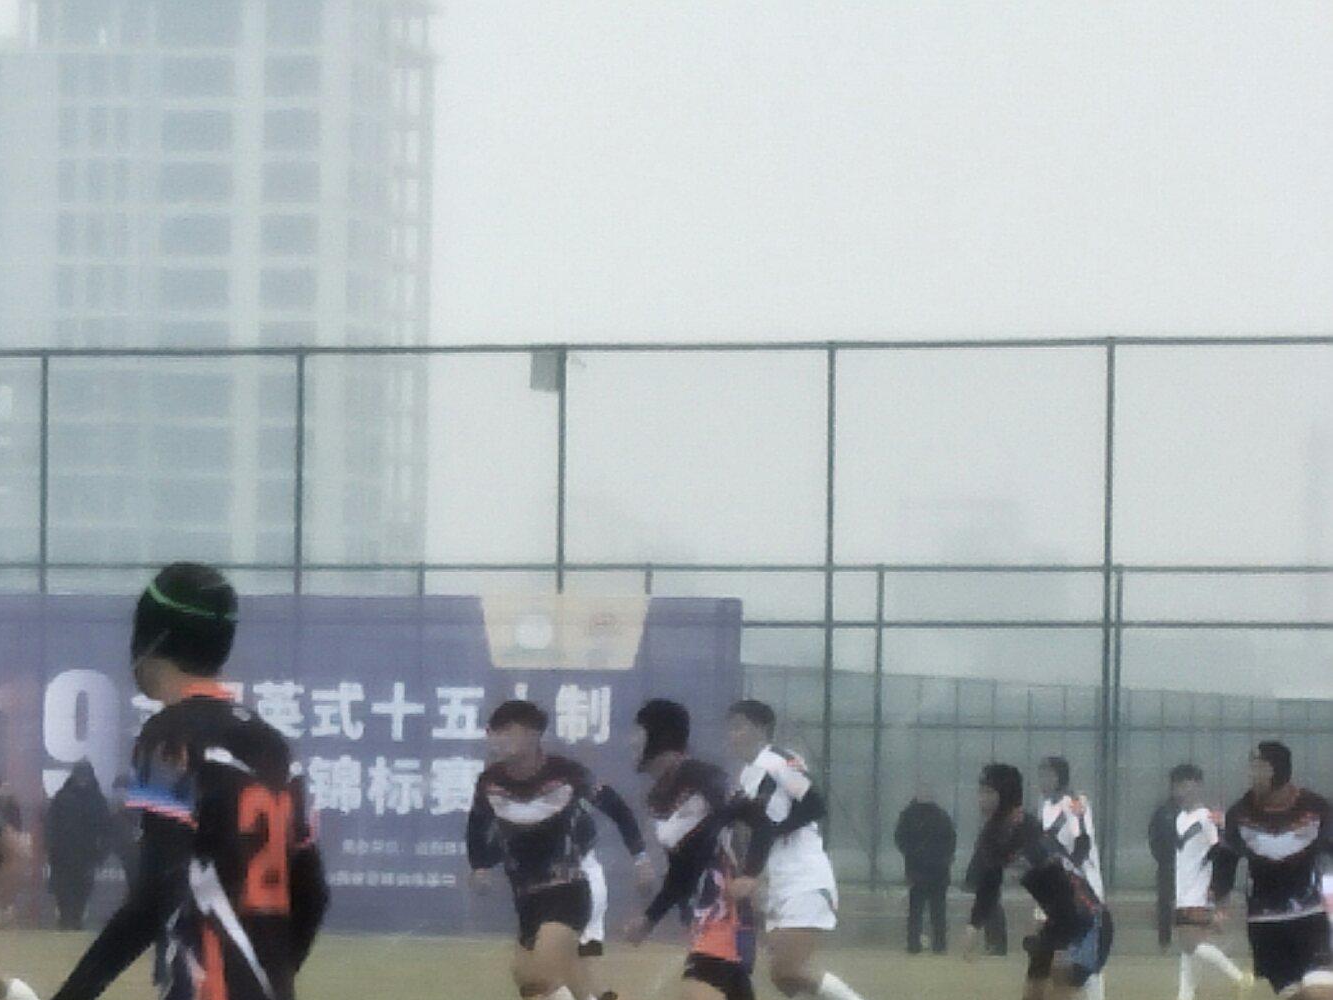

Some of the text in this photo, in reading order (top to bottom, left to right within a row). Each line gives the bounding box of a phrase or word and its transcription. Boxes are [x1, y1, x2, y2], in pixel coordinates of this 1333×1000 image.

[131, 679, 611, 743] 英式十五制
[288, 755, 486, 815] 锦标赛
